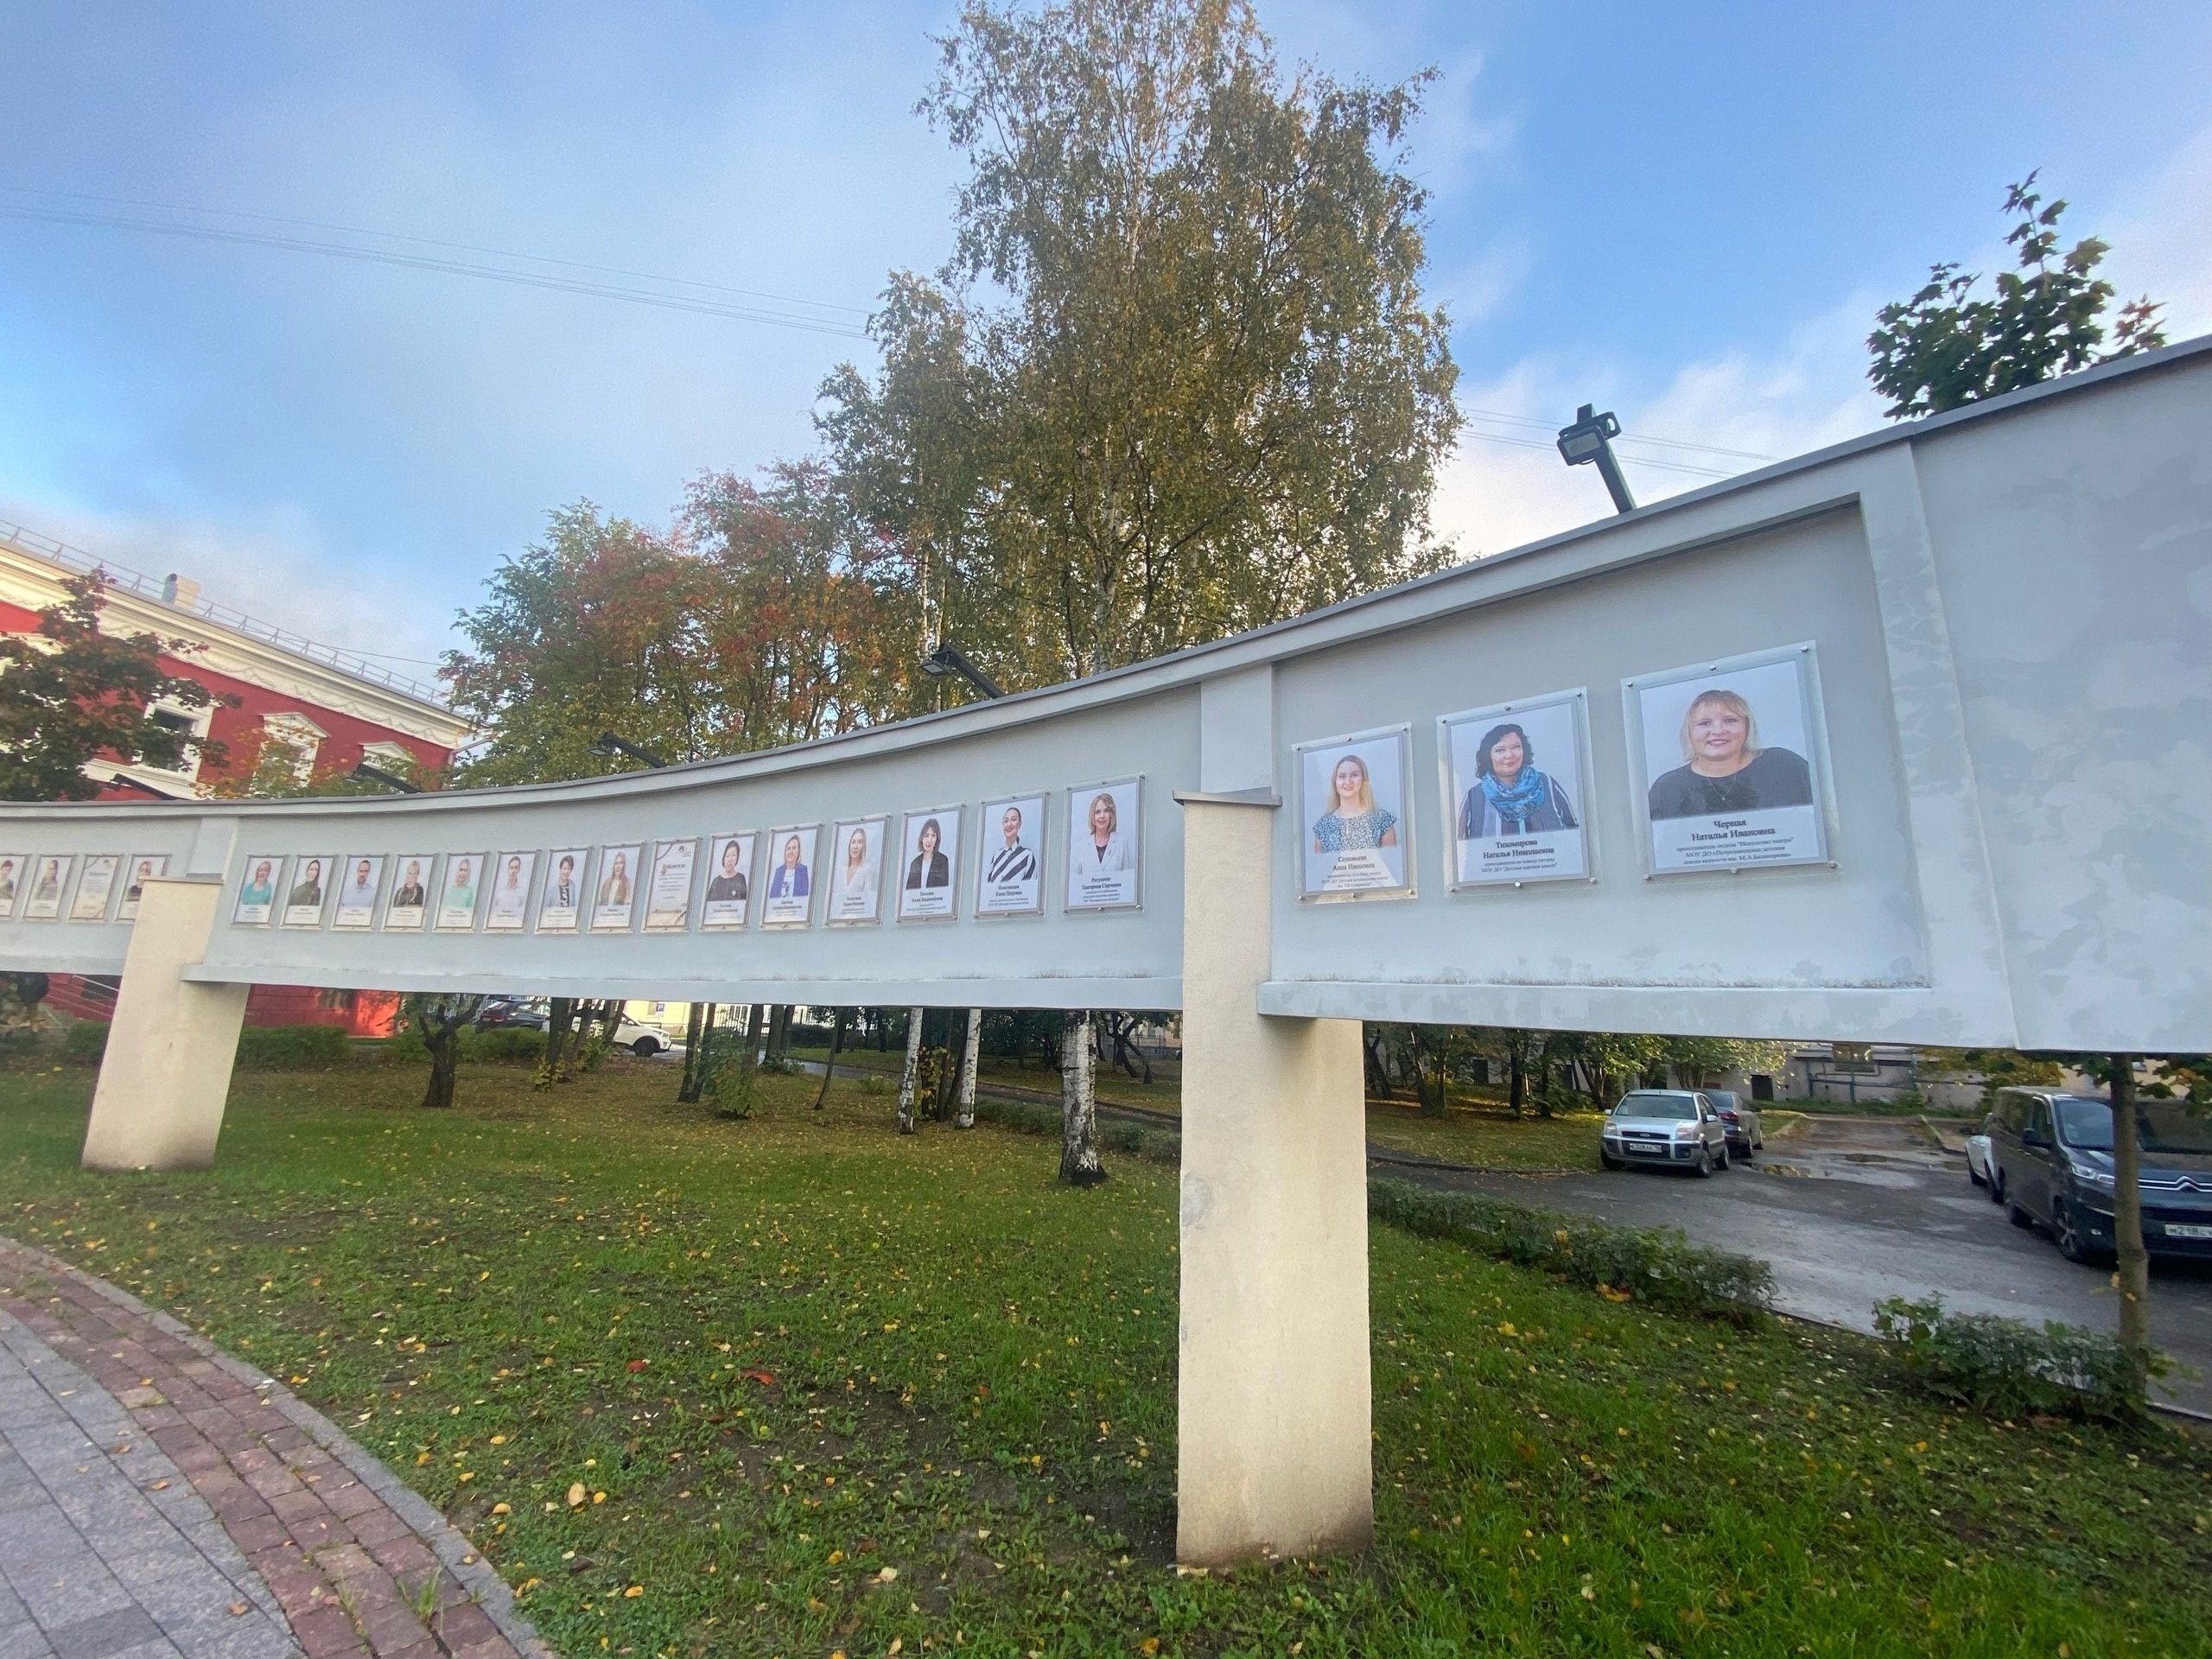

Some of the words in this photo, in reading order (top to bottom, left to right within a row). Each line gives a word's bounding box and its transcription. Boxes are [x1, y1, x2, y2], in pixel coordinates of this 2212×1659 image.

[1713, 820, 1746, 830] Черная
[1692, 832, 1728, 841] Наталья
[1730, 828, 1776, 837] Ивановна
[1496, 840, 1537, 849] Тихомирова
[1512, 848, 1554, 856] Николаевна
